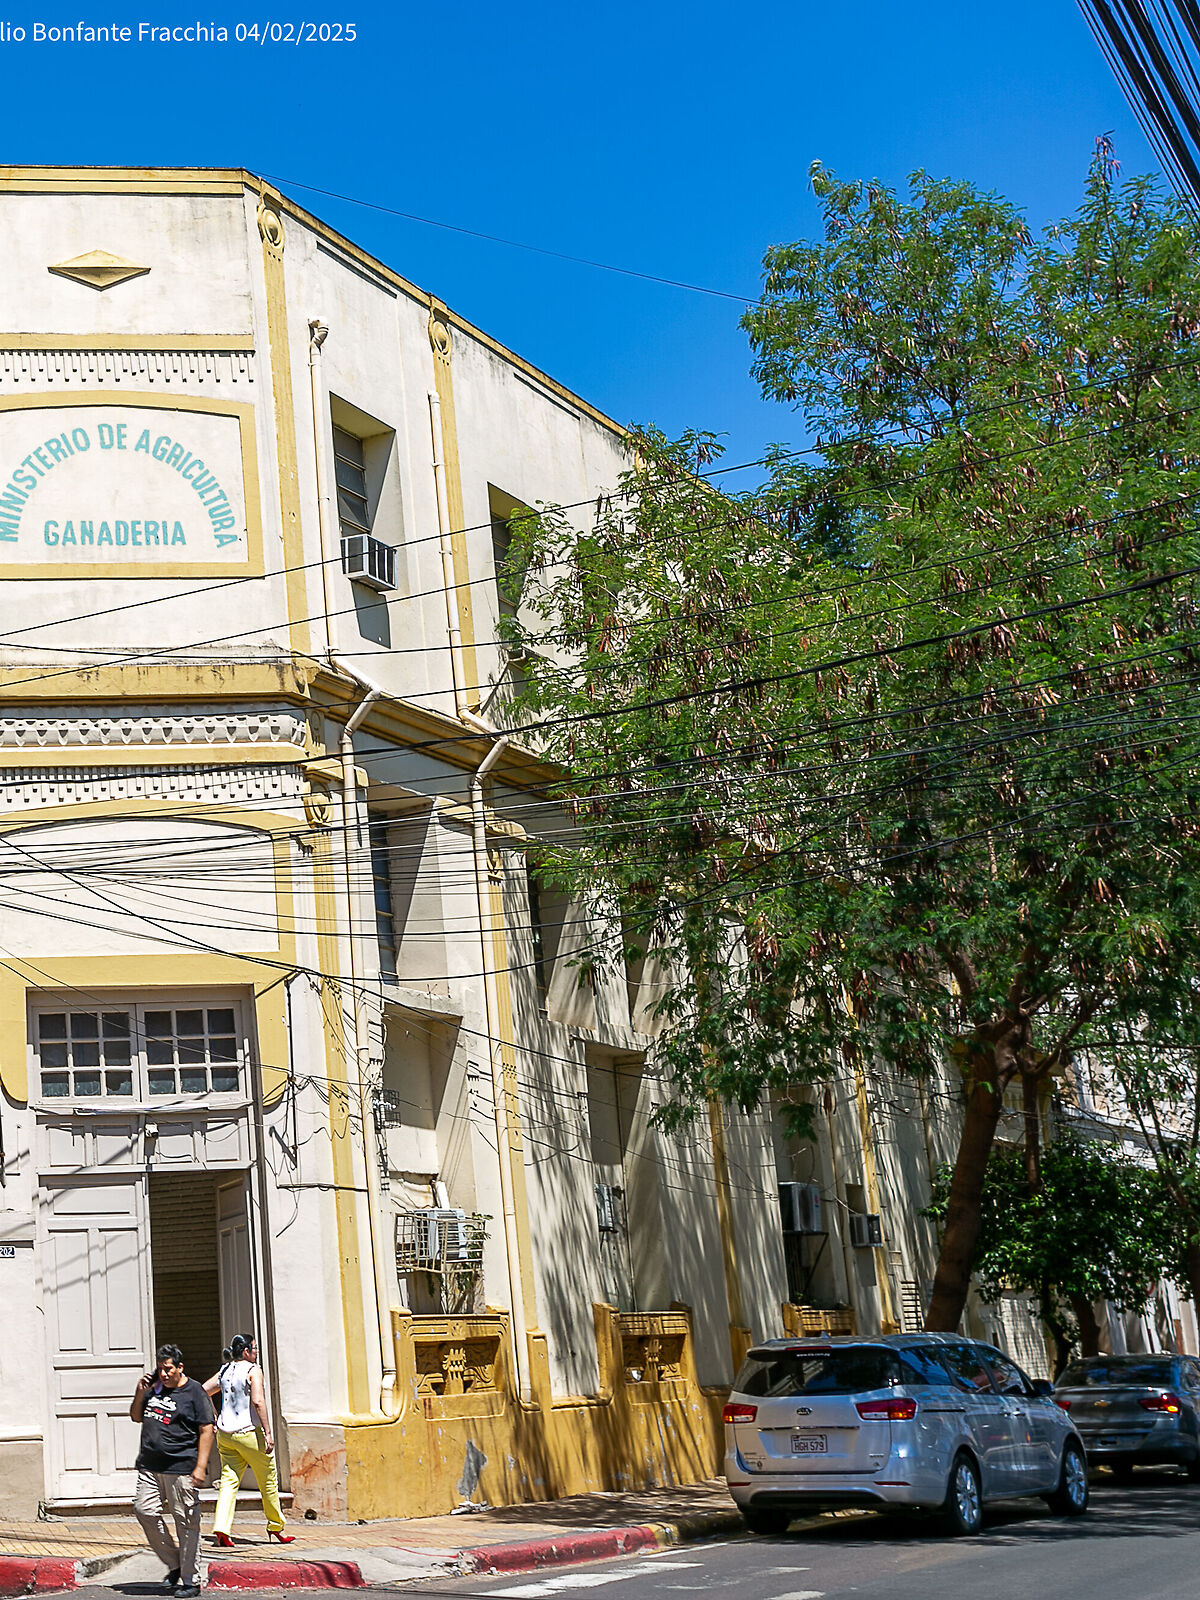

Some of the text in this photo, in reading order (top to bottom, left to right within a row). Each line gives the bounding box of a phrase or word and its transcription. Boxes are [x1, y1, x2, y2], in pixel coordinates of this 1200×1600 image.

[97, 423, 127, 450] DE
[134, 429, 238, 548] AGRICULTURA
[43, 520, 187, 547] GANADERIA
